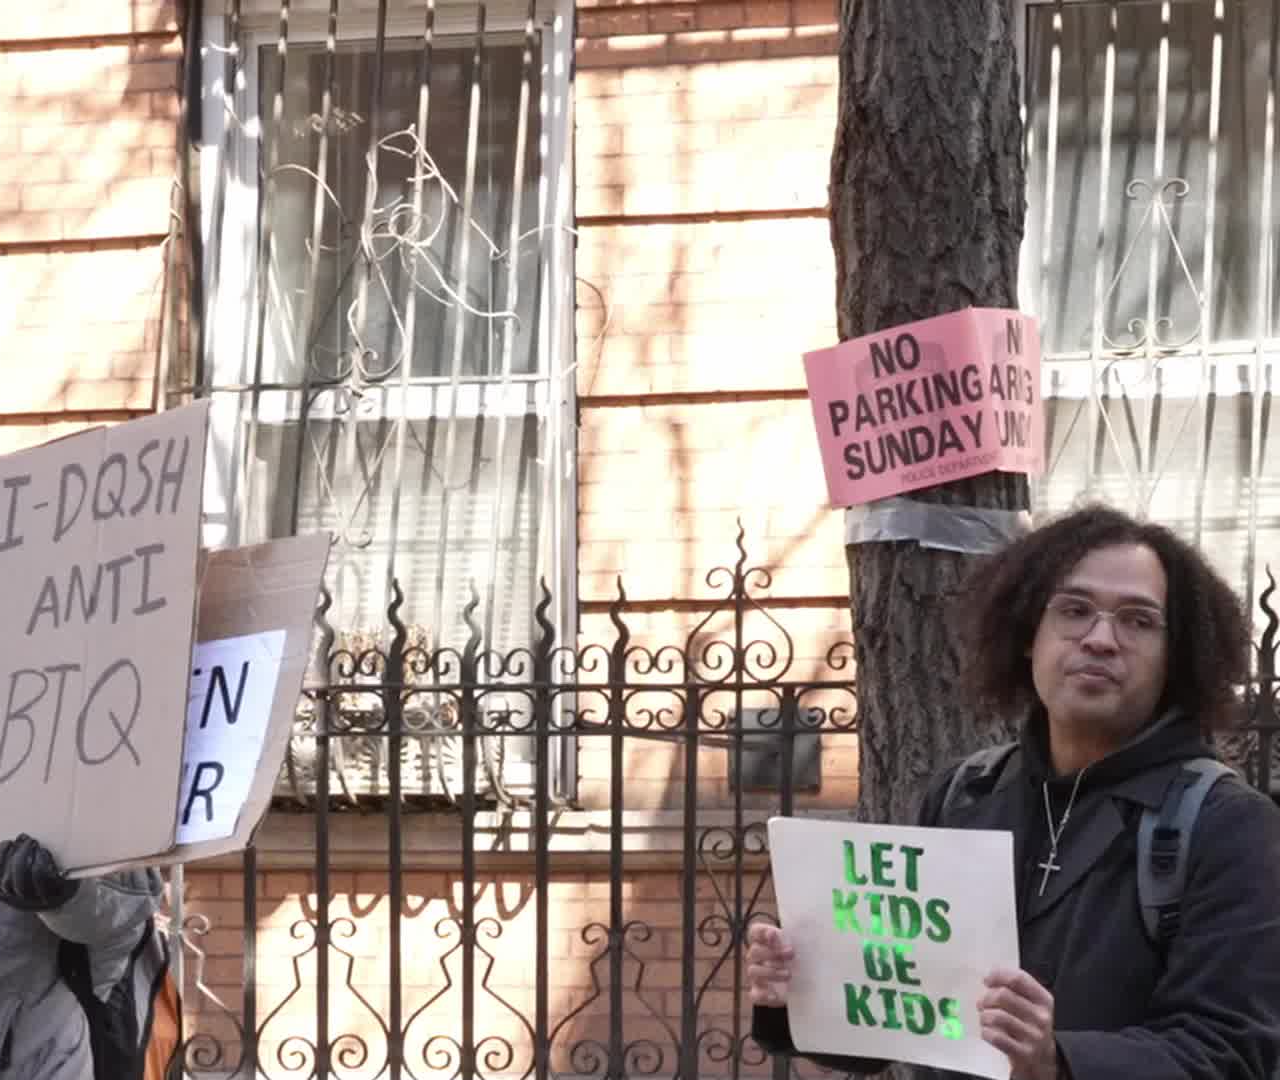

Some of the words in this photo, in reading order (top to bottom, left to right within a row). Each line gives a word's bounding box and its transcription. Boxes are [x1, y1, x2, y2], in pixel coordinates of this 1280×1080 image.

[870, 333, 921, 378] NO
[828, 364, 984, 436] PARKING
[843, 411, 982, 480] SUNDAY
[25, 543, 167, 636] ANTI
[842, 839, 925, 893] LET
[831, 888, 952, 944] KIDS
[844, 983, 962, 1040] KIDS
